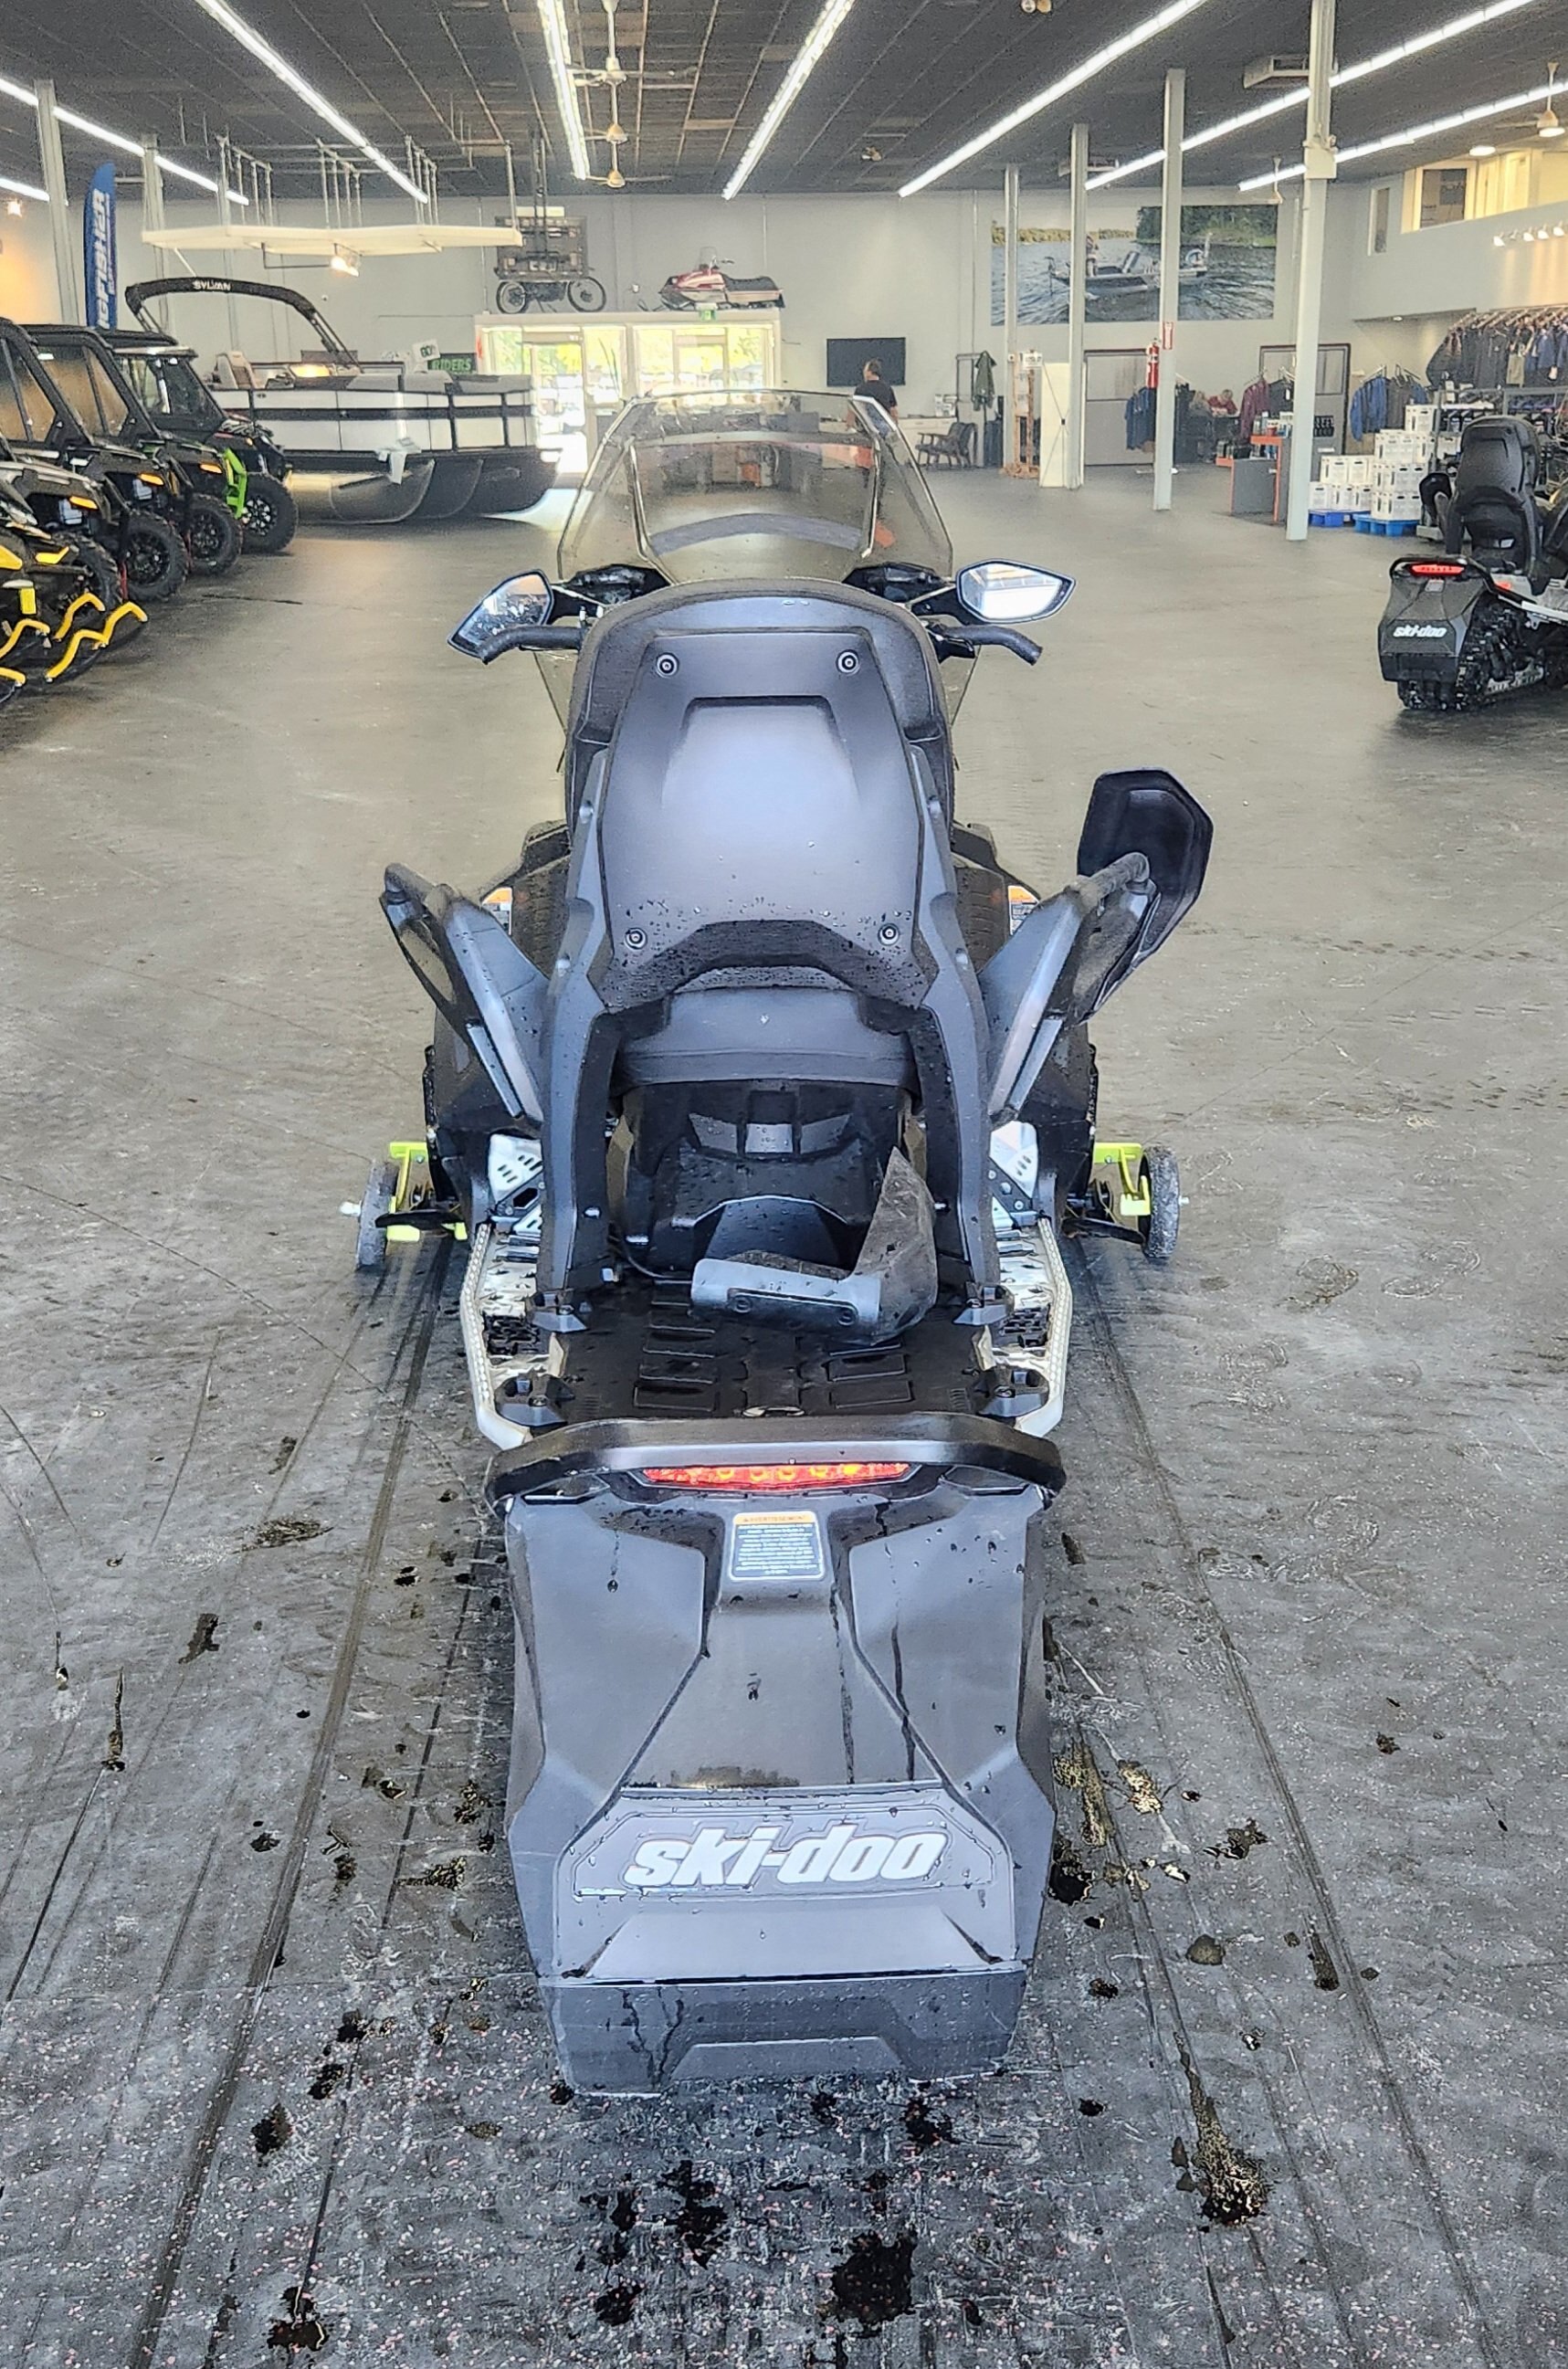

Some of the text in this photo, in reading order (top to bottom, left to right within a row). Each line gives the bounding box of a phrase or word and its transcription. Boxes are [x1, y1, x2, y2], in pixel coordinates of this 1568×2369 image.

[193, 279, 232, 291] SYLVAN
[431, 358, 472, 372] RIDERS
[1393, 625, 1447, 637] ski-doo
[624, 1823, 948, 1887] ski-doo
